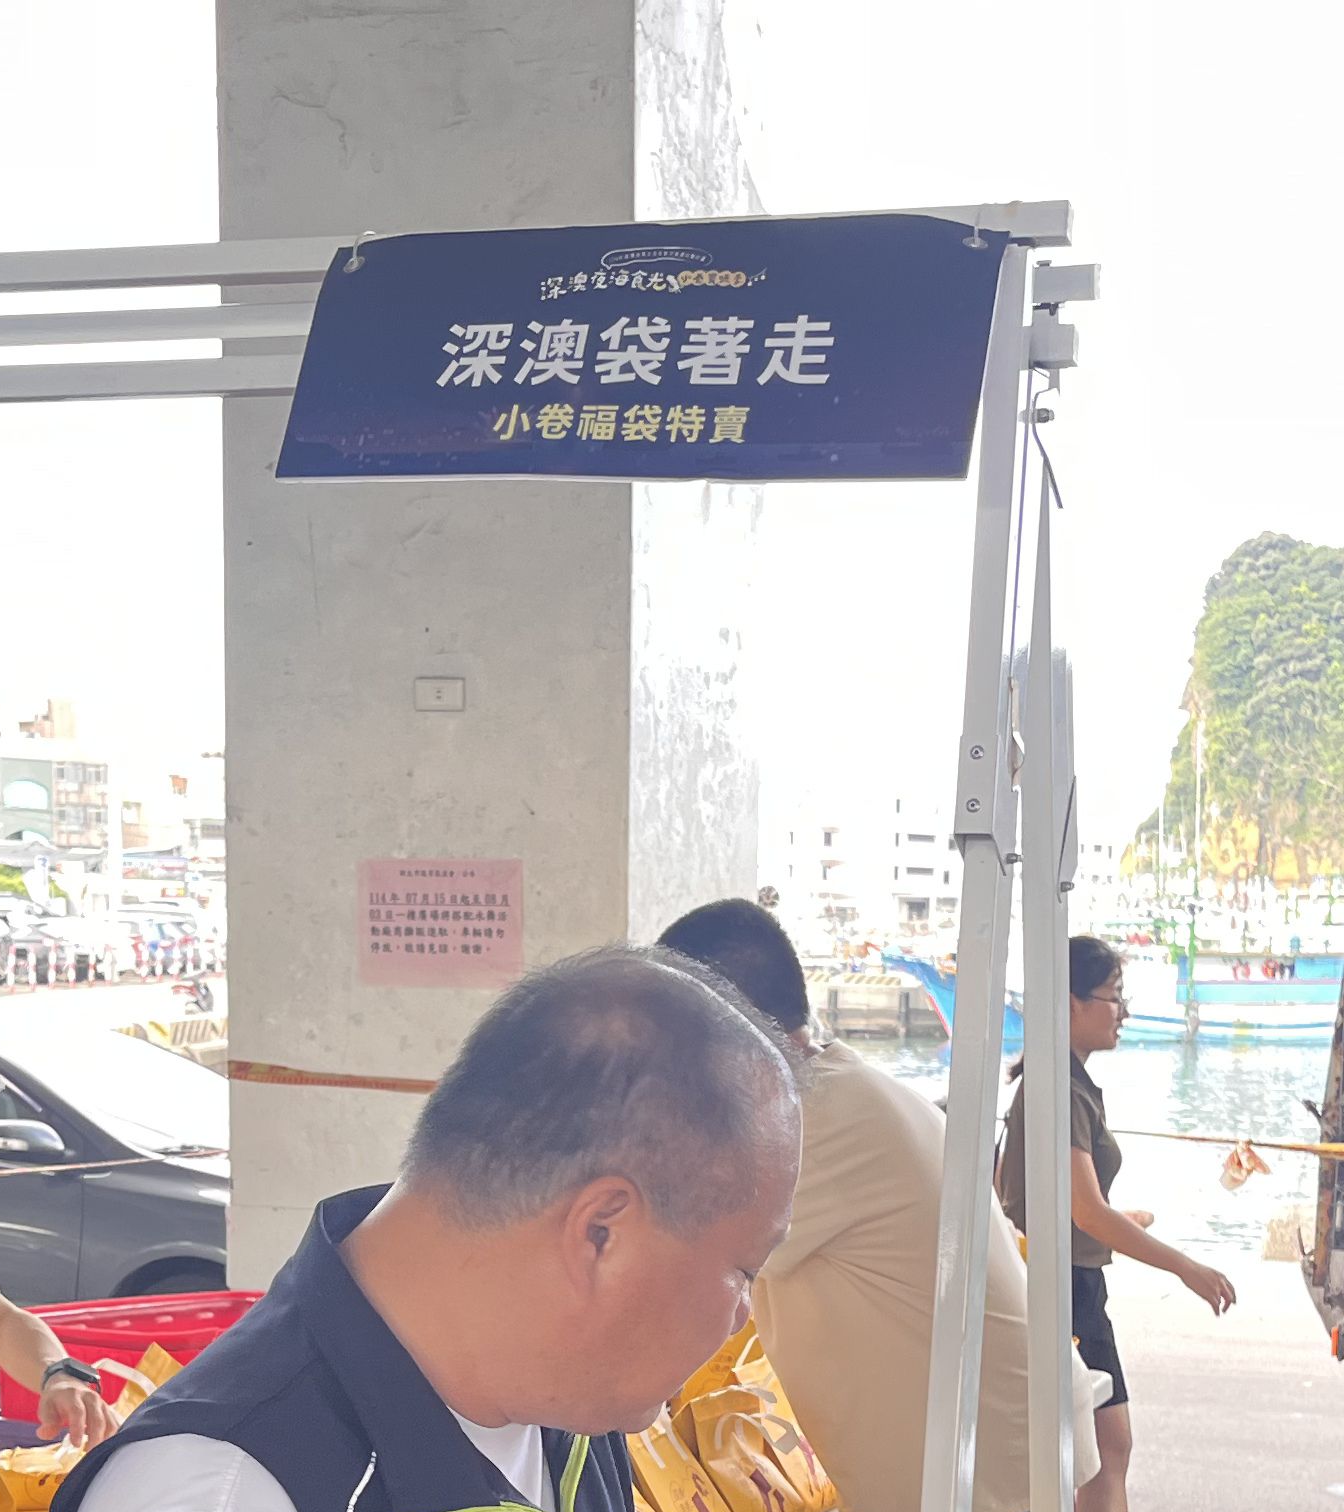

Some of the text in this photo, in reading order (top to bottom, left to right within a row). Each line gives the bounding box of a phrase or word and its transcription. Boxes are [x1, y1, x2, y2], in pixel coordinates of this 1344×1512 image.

[435, 315, 836, 388] 深澳袋著走
[493, 404, 751, 445] 小卷福袋特賣
